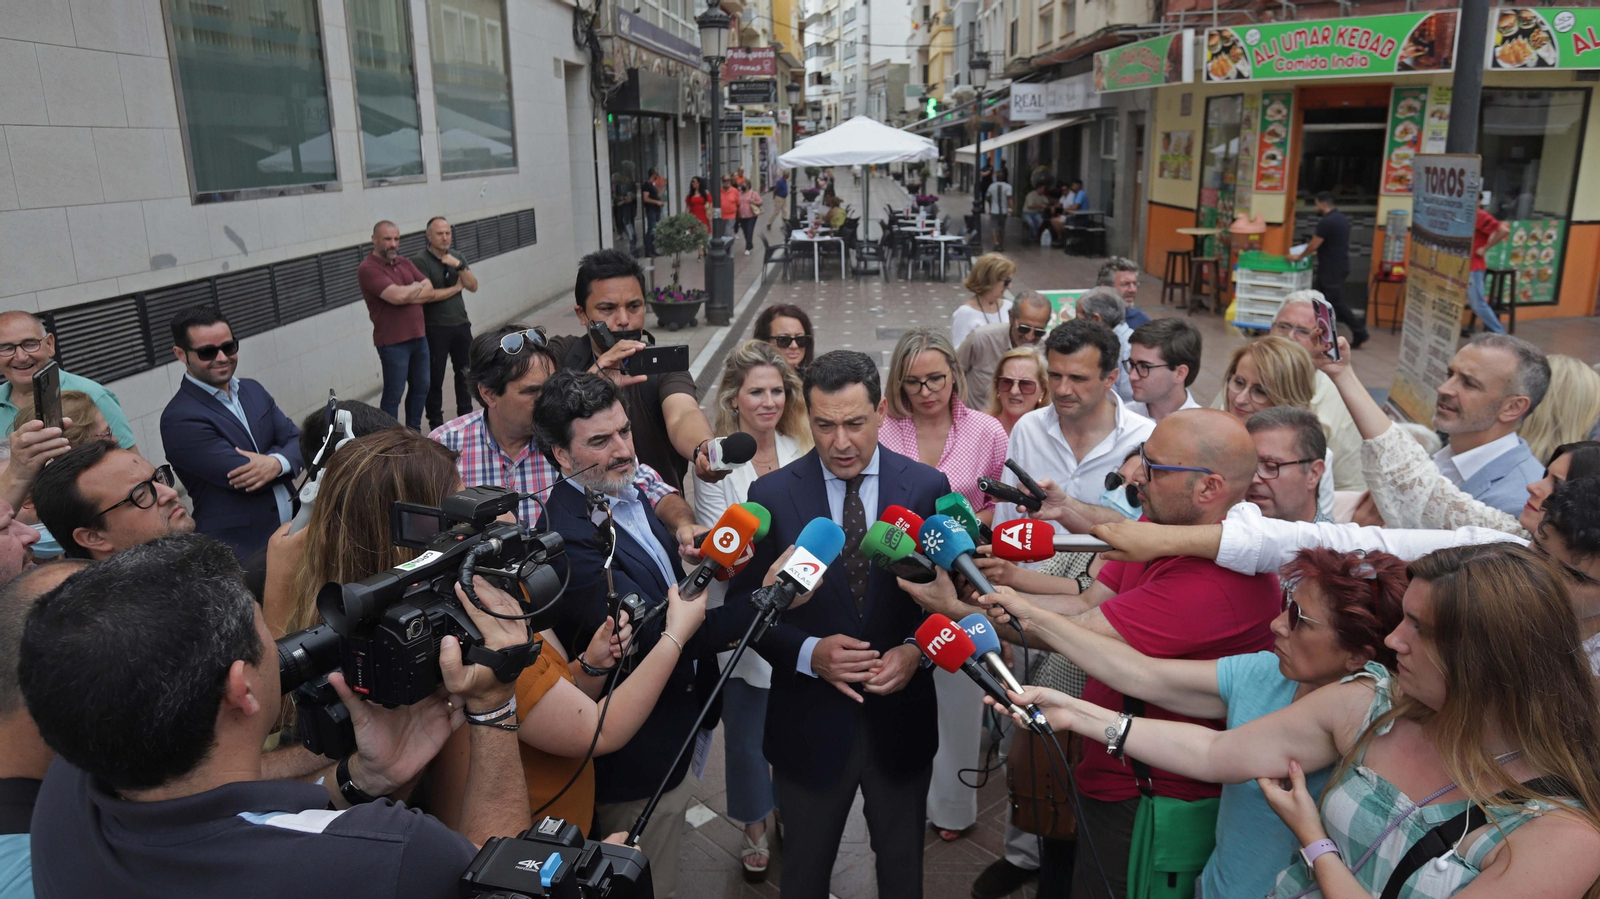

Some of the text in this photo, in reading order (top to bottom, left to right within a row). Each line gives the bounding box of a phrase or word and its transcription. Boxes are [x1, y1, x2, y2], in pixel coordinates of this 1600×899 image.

[1253, 25, 1397, 67] ALI UMAR KEBAB
[1275, 55, 1328, 71] Comida
[1014, 93, 1044, 109] REAL
[1424, 166, 1466, 198] TOROS
[789, 567, 812, 586] ATLAS
[927, 627, 956, 656] rne
[518, 859, 543, 870] 4K
